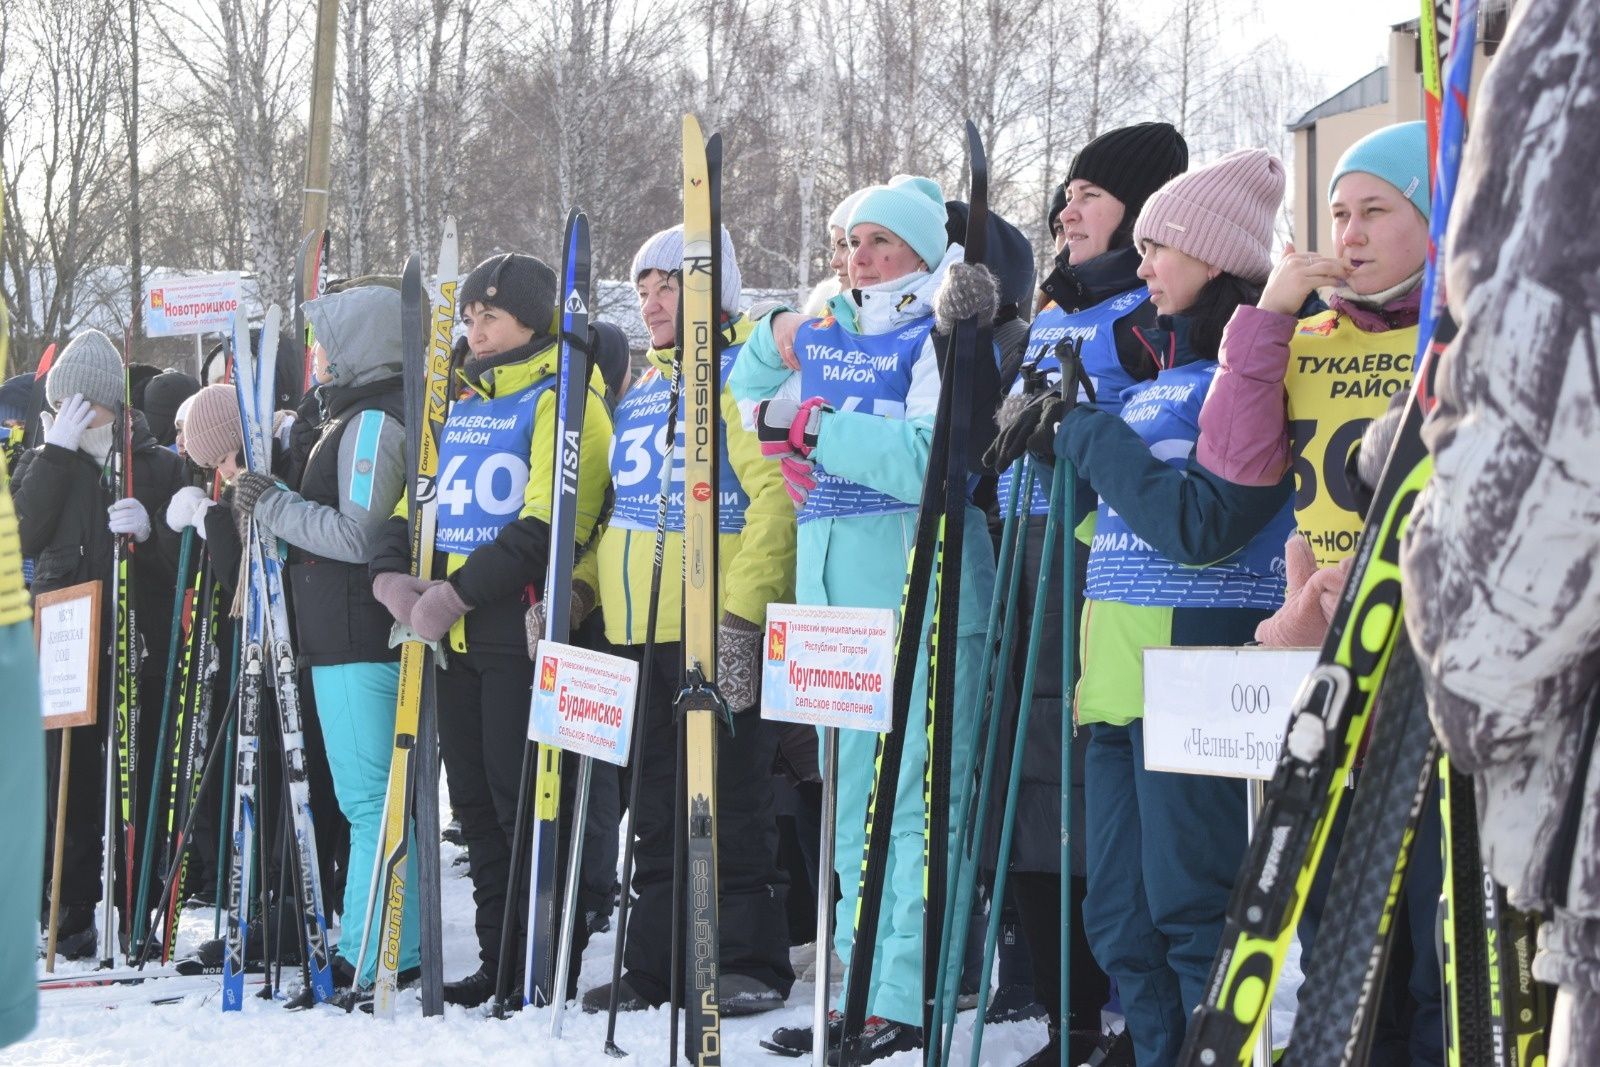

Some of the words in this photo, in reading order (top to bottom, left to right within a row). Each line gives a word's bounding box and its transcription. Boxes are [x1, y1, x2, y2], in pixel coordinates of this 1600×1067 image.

[164, 300, 237, 317] Новотроицкое
[429, 280, 458, 424] KARJALA
[823, 363, 876, 383] РАЙОН
[692, 321, 712, 463] rossignol
[445, 427, 490, 446] РАЙОН
[421, 433, 431, 472] Country
[561, 430, 579, 496] TISA
[437, 452, 530, 516] 40
[413, 508, 424, 531] Russia
[789, 620, 820, 634] Тукаевский
[820, 624, 867, 635] муниципальный
[868, 628, 887, 637] район
[804, 641, 837, 653] Республики
[839, 643, 868, 655] Татарстан
[789, 660, 882, 692] Круглопольское
[558, 685, 622, 728] Бурдинское
[795, 696, 830, 710] сельское
[831, 700, 873, 714] поселение
[1231, 683, 1271, 714] ООО
[558, 725, 585, 740] сельское
[586, 732, 617, 749] поселение
[383, 872, 406, 972] Country
[306, 922, 326, 960] XC
